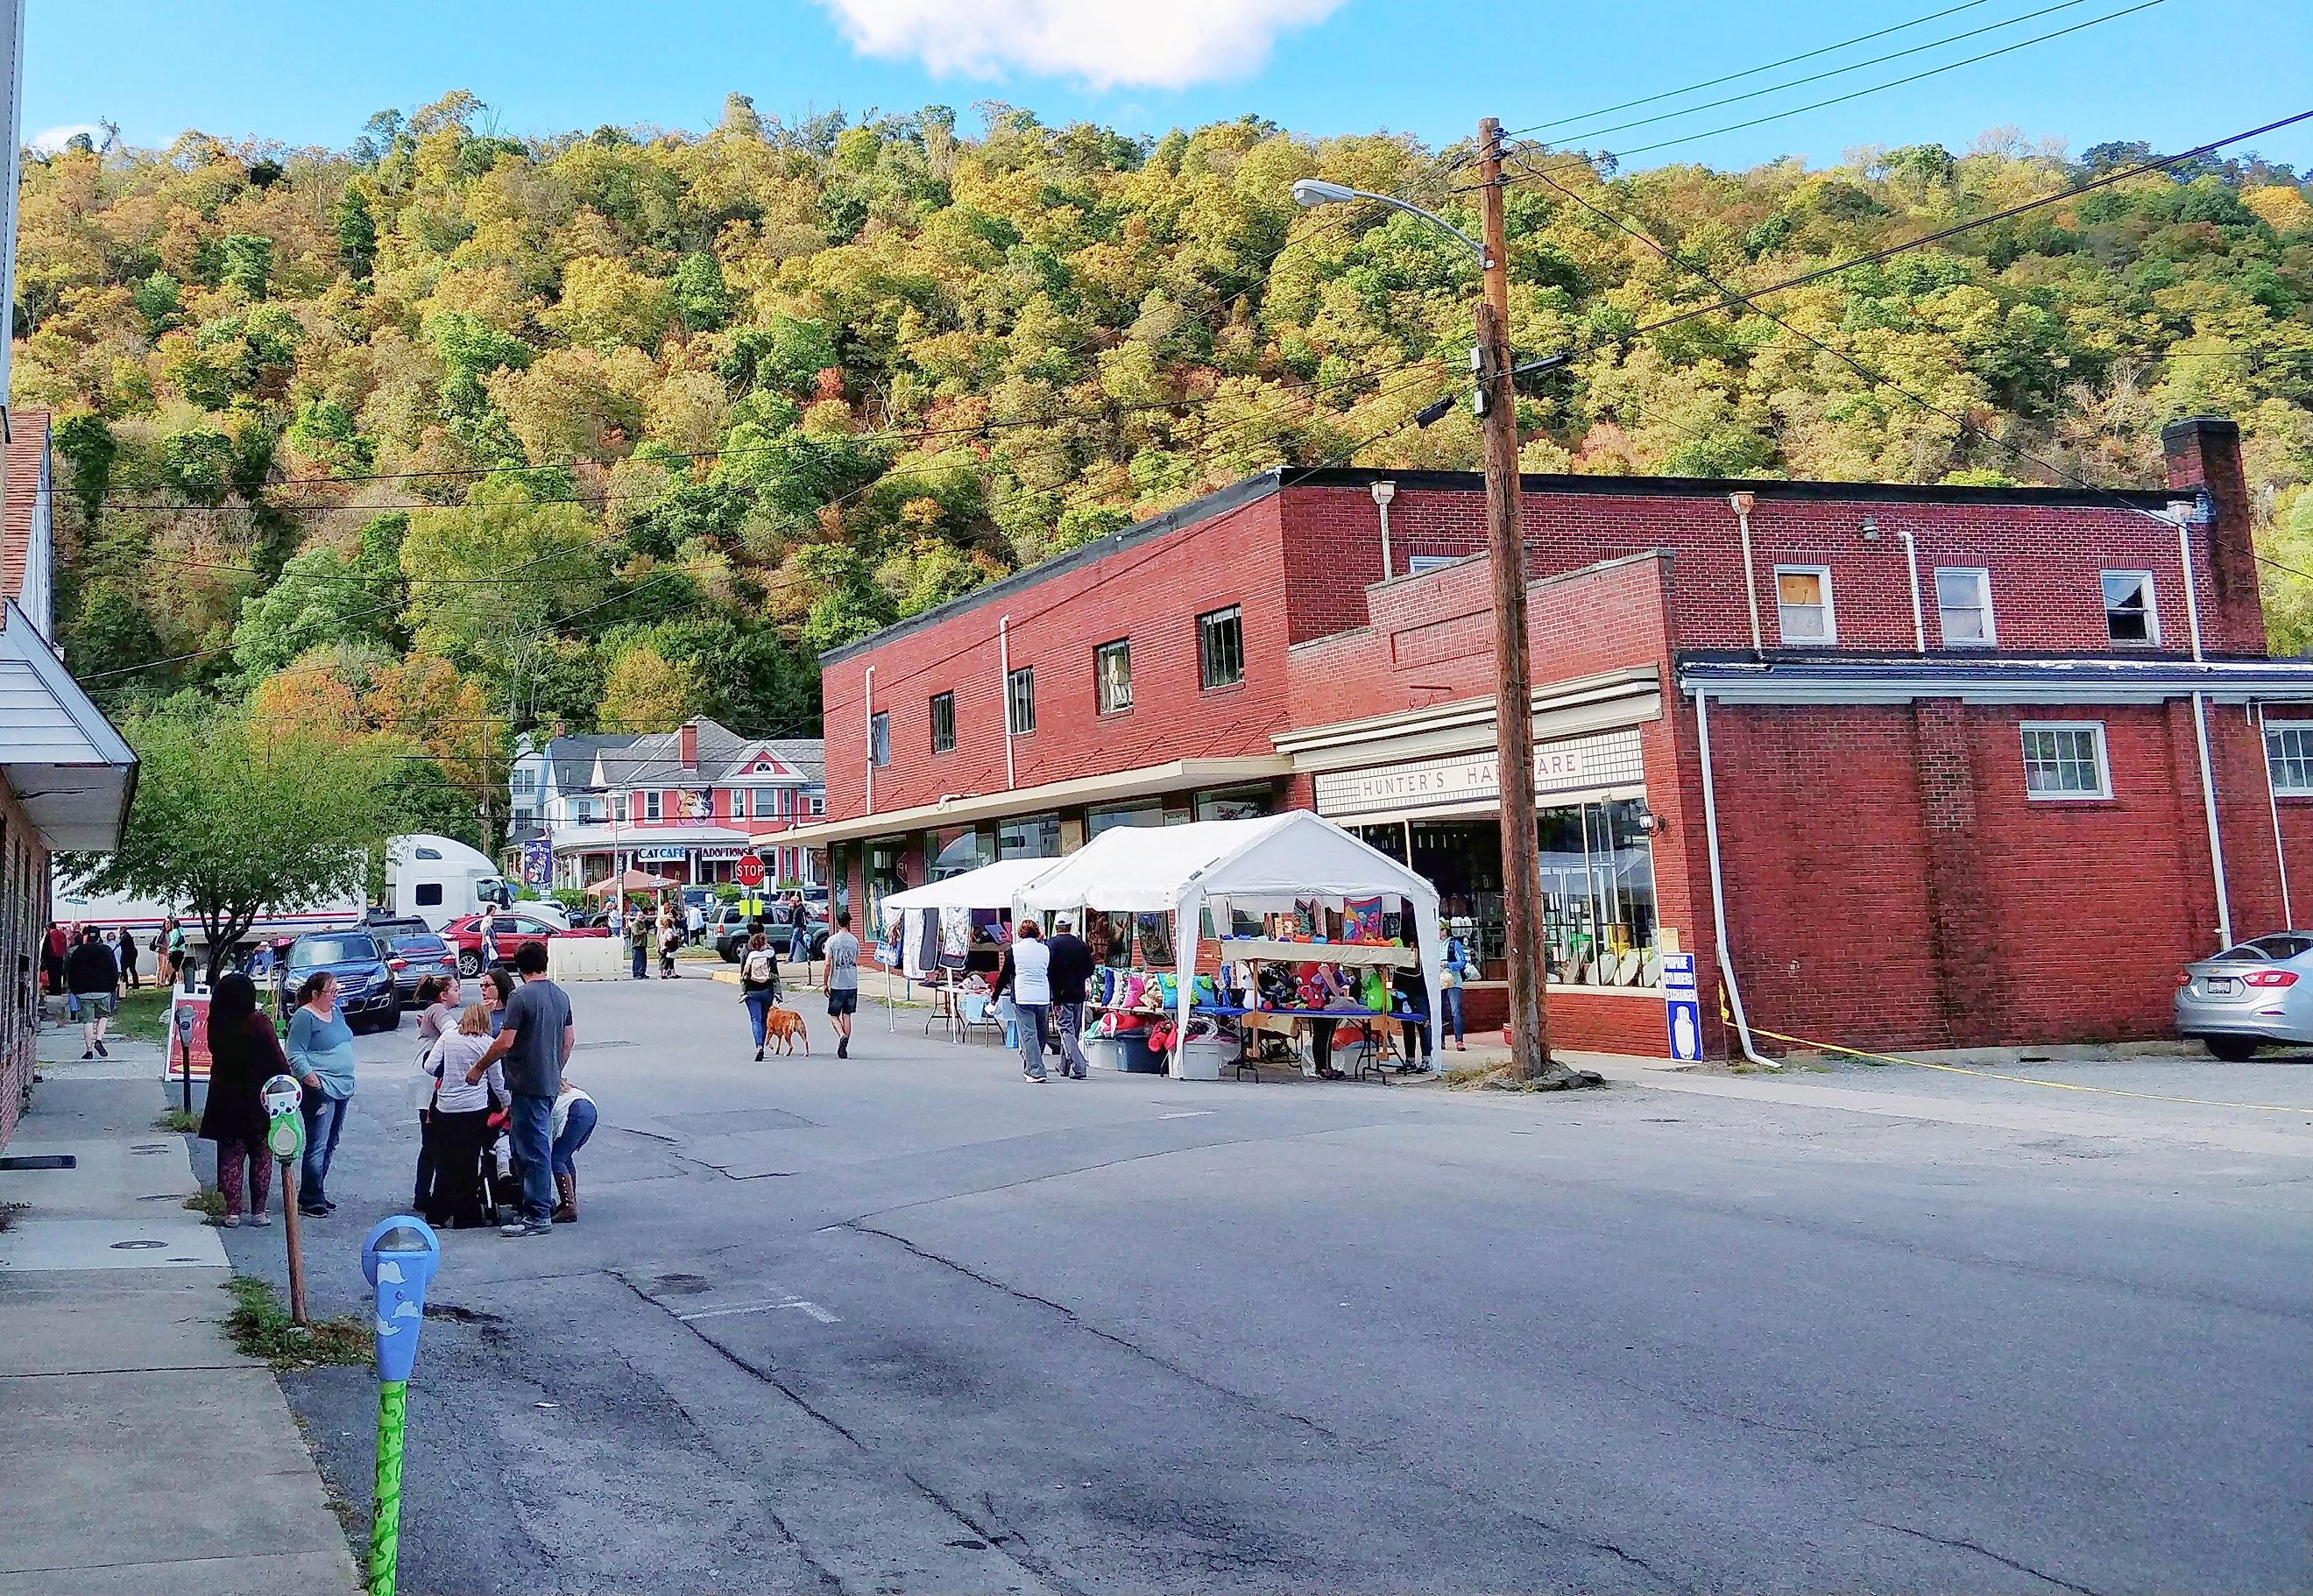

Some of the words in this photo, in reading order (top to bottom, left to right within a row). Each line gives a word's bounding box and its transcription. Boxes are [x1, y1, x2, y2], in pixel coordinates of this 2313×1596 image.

[1363, 772, 1444, 796] HUNTER'S
[1467, 753, 1576, 784] HAARE
[639, 848, 659, 858] CAT
[659, 846, 685, 858] CAFÉ
[737, 865, 764, 877] STOP
